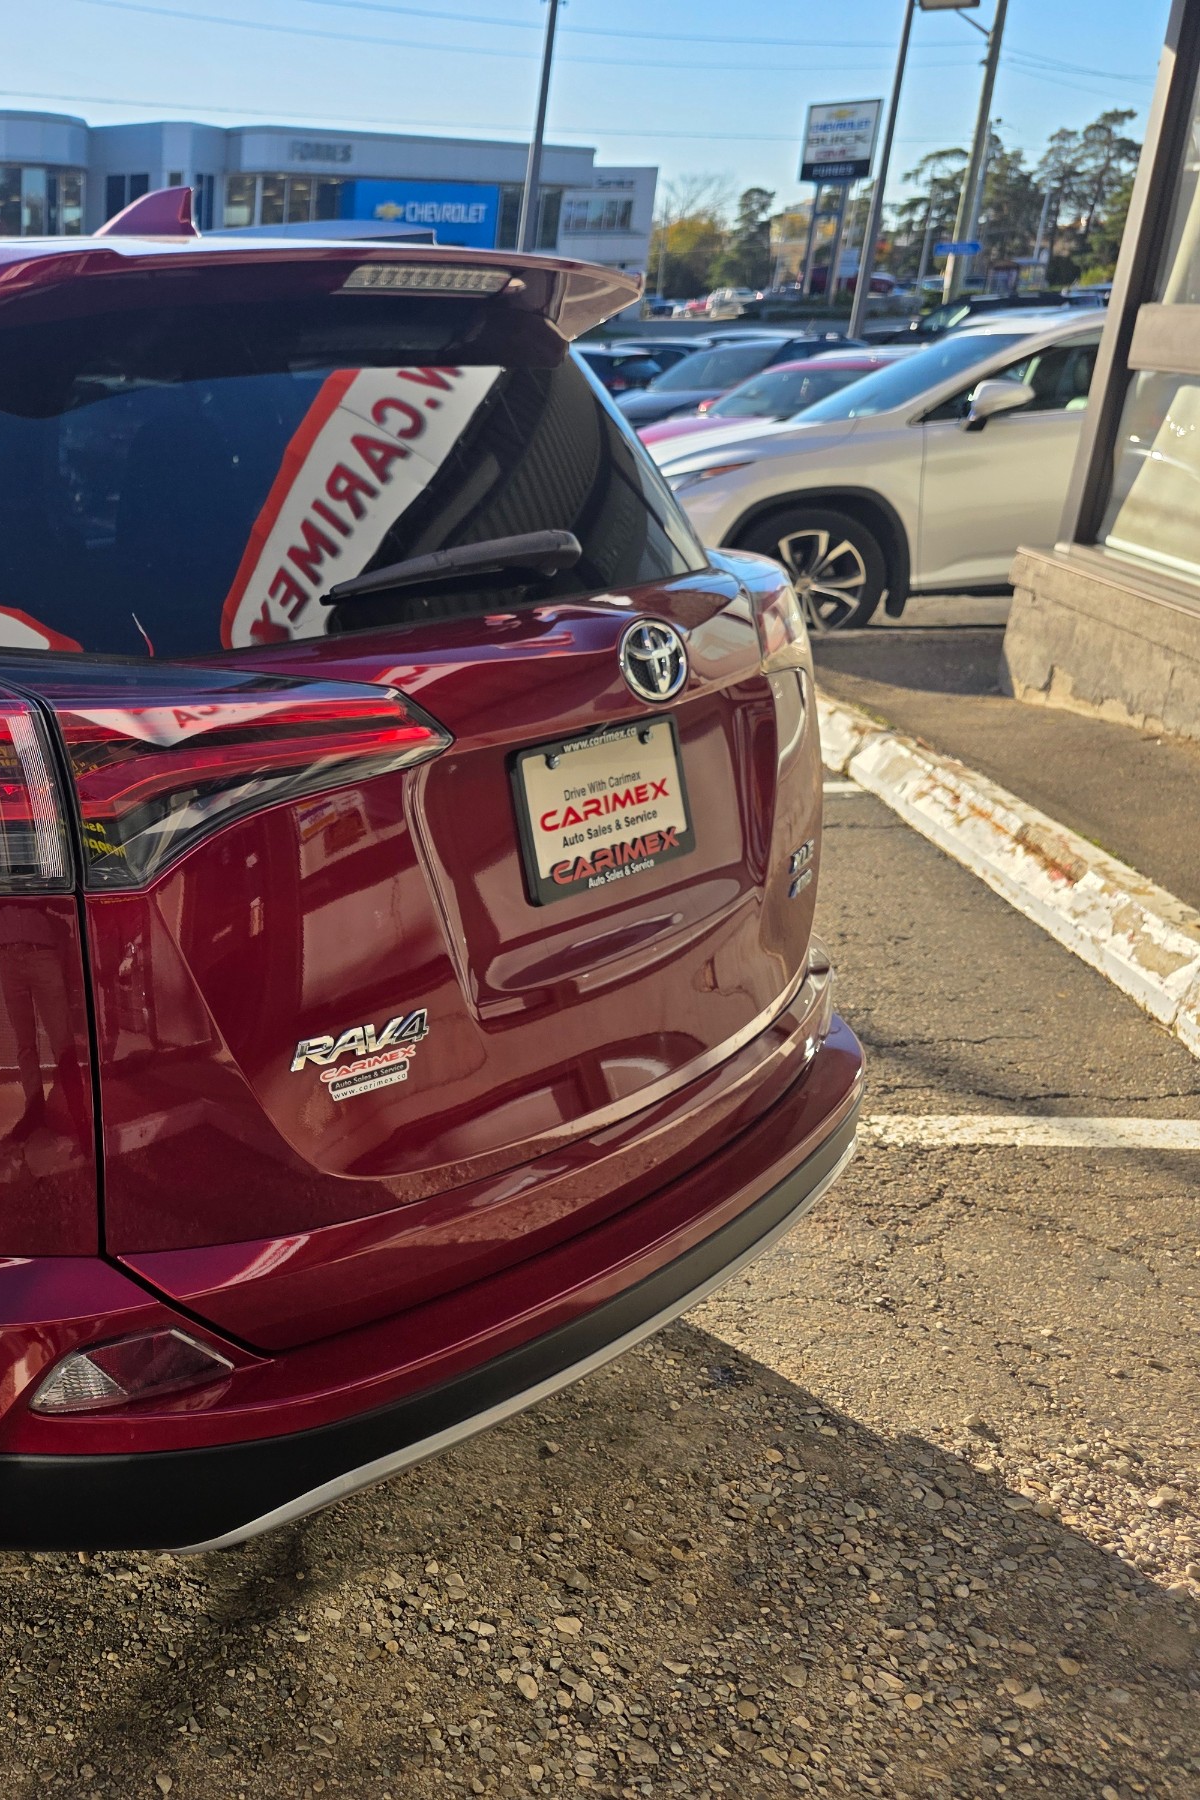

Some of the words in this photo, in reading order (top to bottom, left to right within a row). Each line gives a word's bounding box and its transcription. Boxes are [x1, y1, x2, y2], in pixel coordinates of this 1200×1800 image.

[405, 201, 487, 224] CHEVROLET
[563, 726, 637, 753] www.carimex.ca
[564, 785, 587, 802] Drive
[587, 779, 607, 794] With
[608, 770, 641, 788] Carimex
[540, 778, 669, 832] CARIMEX
[562, 830, 585, 848] Auto
[587, 823, 612, 840] Sales
[615, 819, 622, 831] &
[624, 808, 658, 827] Service
[552, 827, 679, 885] CARIMEX
[588, 874, 605, 889] Auto
[605, 868, 624, 883] Sales
[624, 865, 631, 877] &
[631, 858, 655, 873] Service
[290, 1008, 429, 1072] RAV4
[321, 1045, 416, 1081] CARIMEX
[335, 1079, 352, 1090] Auto
[353, 1073, 372, 1085] Sales
[373, 1070, 379, 1078] &
[380, 1064, 404, 1077] Service
